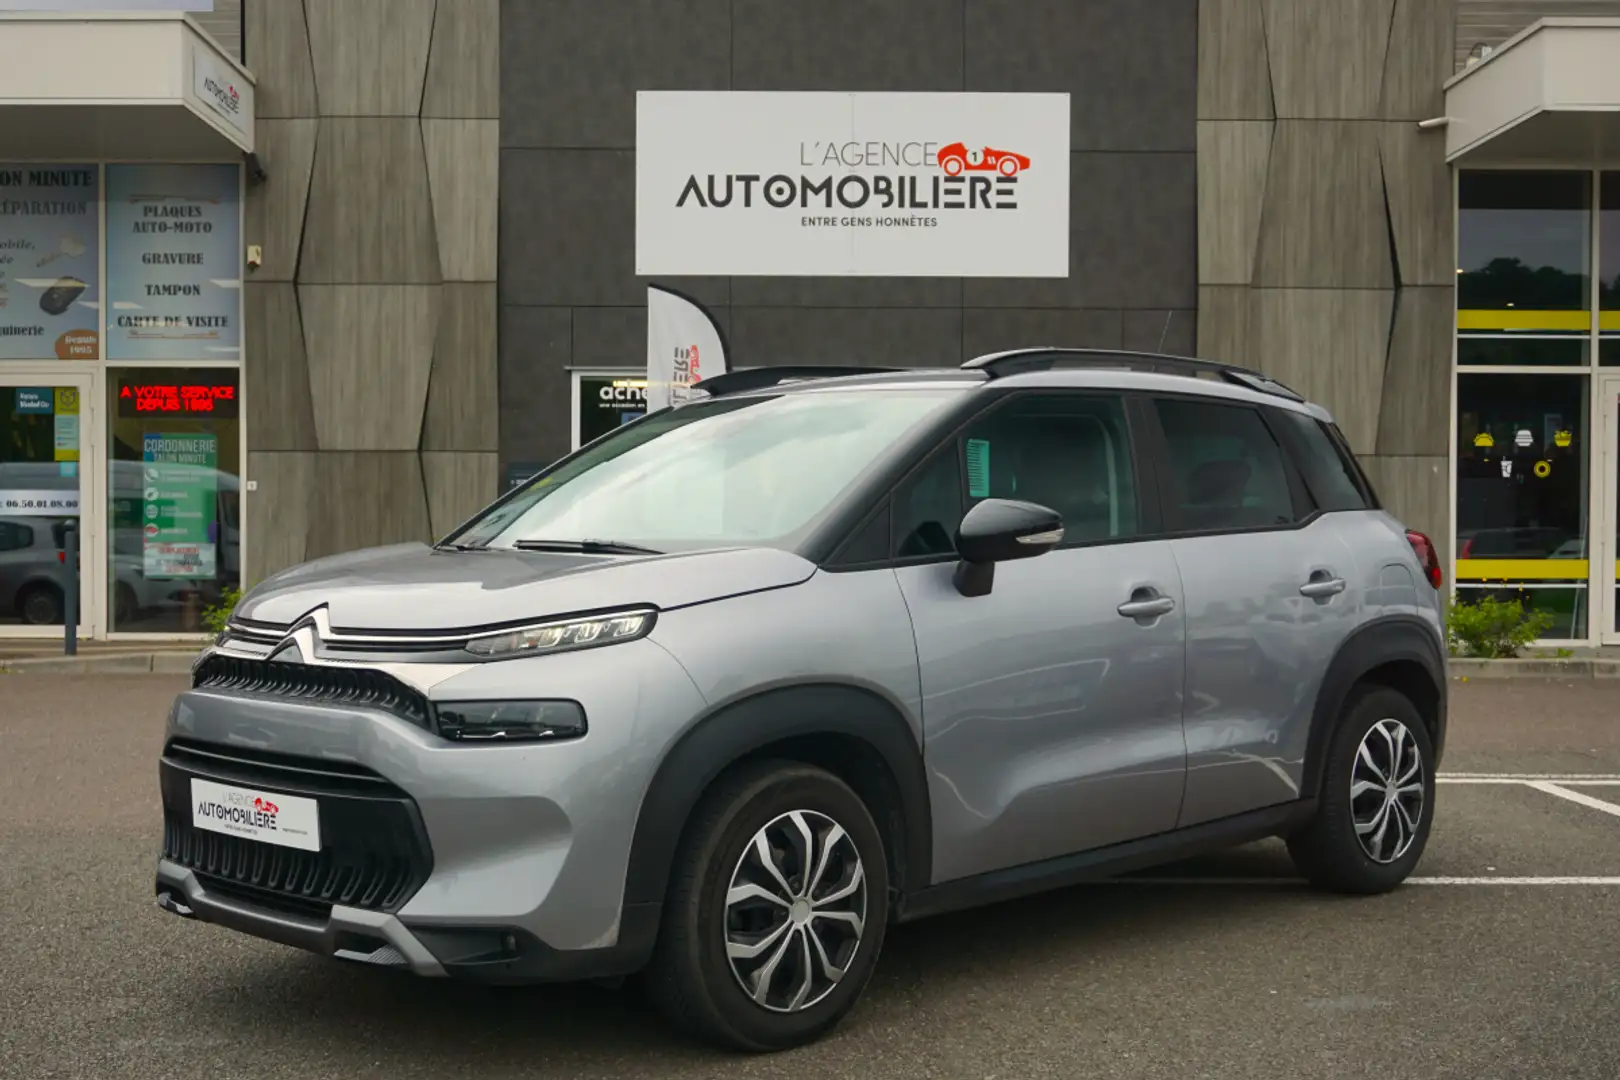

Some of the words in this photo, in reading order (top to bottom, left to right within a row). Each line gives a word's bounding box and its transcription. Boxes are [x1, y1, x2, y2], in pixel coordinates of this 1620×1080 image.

[801, 141, 938, 166] L'AGENCE
[29, 170, 93, 187] MINUTE
[675, 174, 1018, 209] AUTOMOBILIERE
[143, 205, 202, 218] PLAQUES
[132, 221, 212, 233] AUTO-MOTO
[801, 216, 837, 226] ENTRE
[841, 217, 872, 227] GENS
[142, 252, 204, 265] GRAVURE
[145, 284, 201, 296] TAMPON
[118, 316, 159, 327] CARTE
[164, 316, 183, 327] DE
[186, 315, 229, 327] VISITE
[120, 385, 132, 398] A
[134, 385, 178, 398] VOTRE
[180, 385, 234, 399] SERVICE
[136, 398, 181, 411] DEPUIS
[144, 439, 216, 453] CORDONNERIE
[153, 453, 177, 463] TALON
[178, 453, 206, 464] MINUTE
[198, 800, 277, 830] AUTOMOBILIERE
